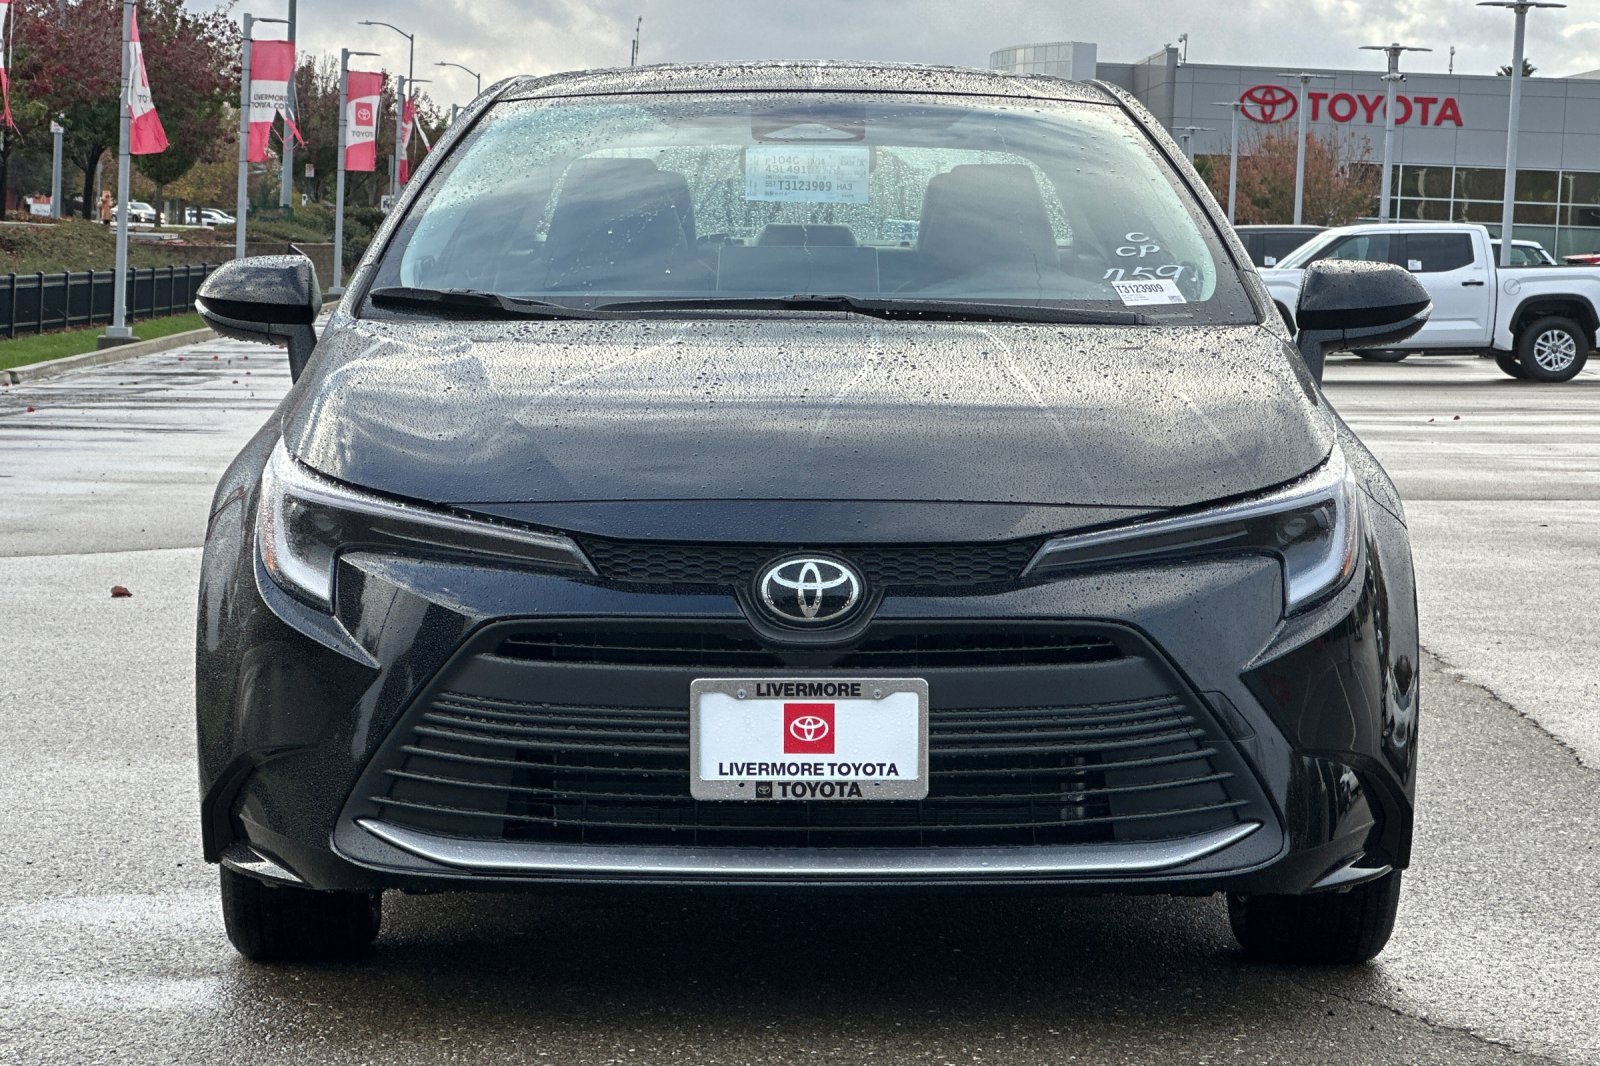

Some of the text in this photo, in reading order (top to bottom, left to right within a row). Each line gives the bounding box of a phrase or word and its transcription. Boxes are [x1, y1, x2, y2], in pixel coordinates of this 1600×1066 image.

[1307, 92, 1463, 127] TOYOTA
[778, 180, 832, 191] T3123909
[1116, 283, 1164, 294] T3123909
[756, 682, 861, 697] LIVERMORE
[718, 762, 899, 777] LIVERMORE TOYOTA
[778, 781, 863, 798] TOYOTA
